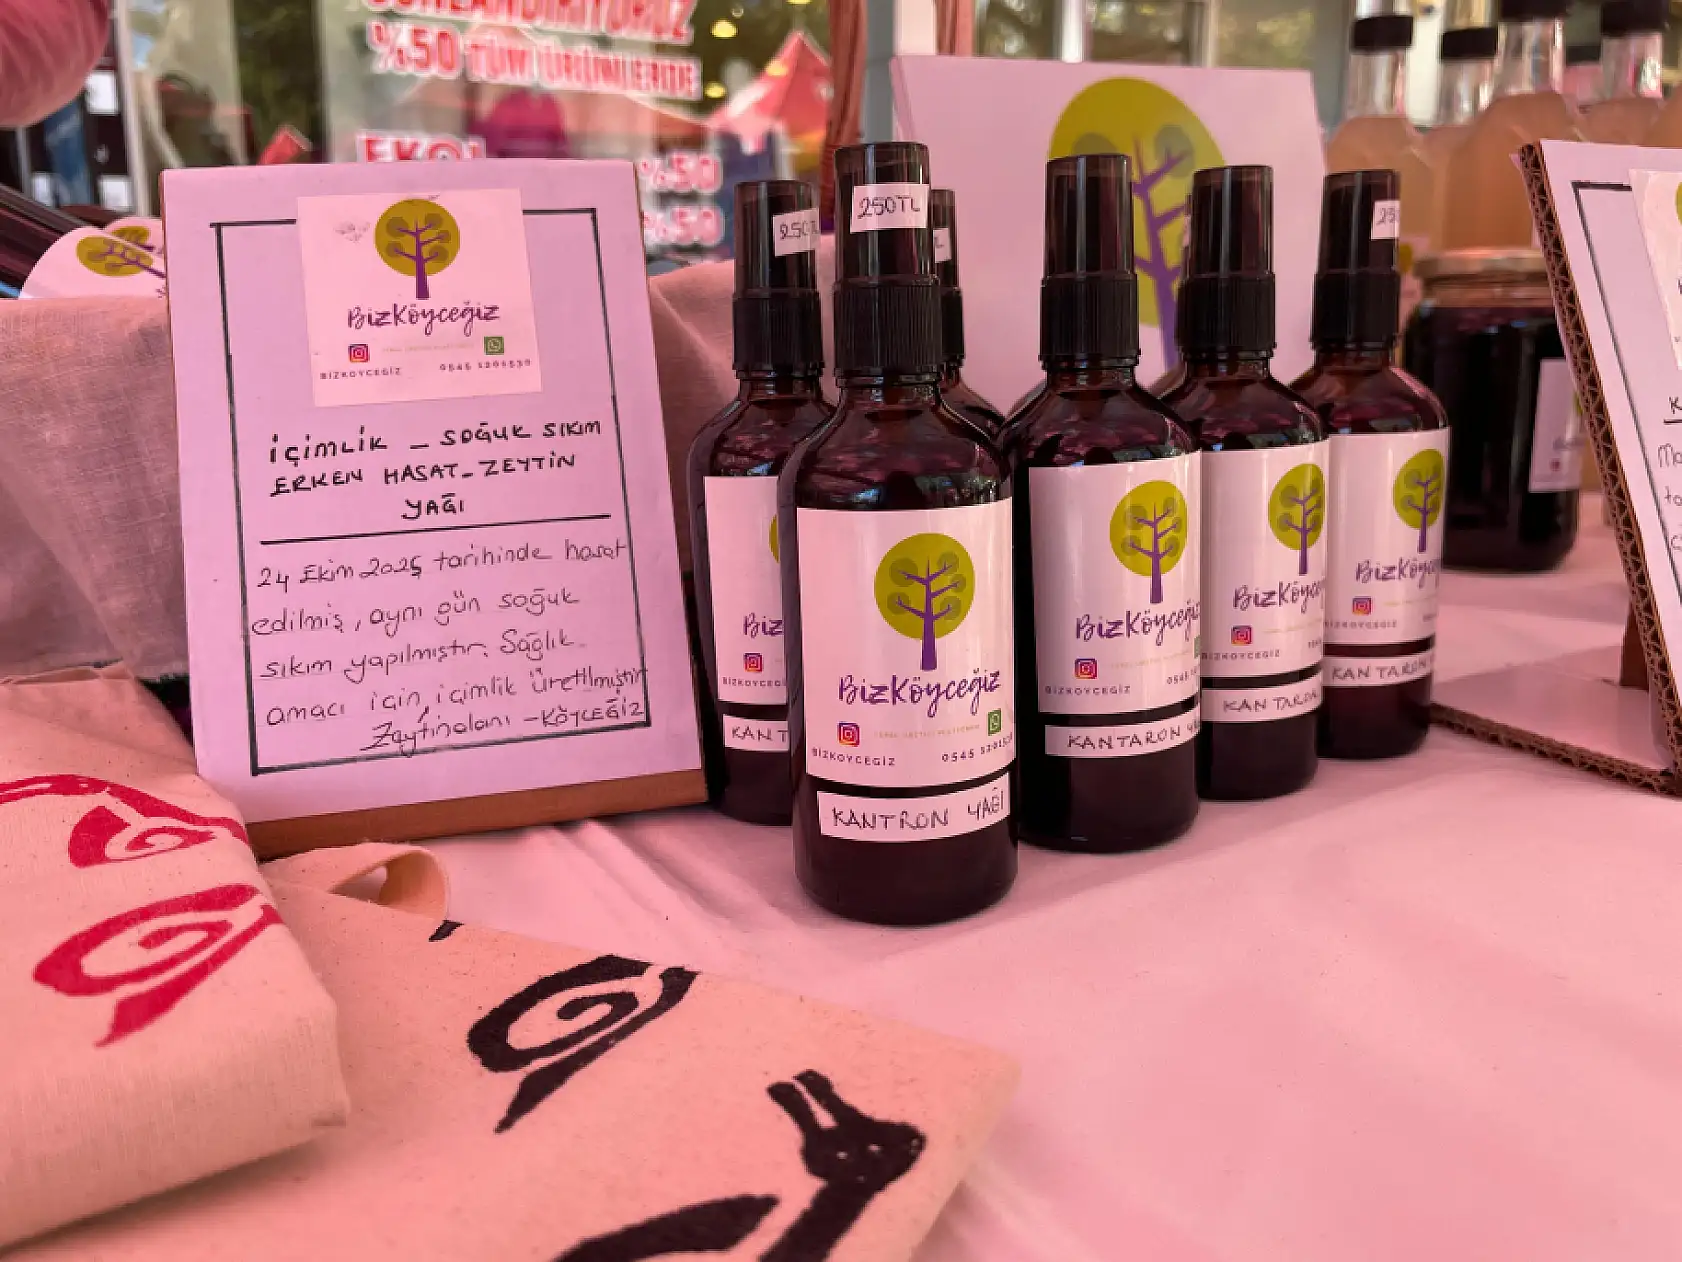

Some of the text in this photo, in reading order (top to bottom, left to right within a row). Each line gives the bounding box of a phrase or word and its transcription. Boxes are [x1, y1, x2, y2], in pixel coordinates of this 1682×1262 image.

[370, 21, 456, 74] %50
[857, 195, 921, 219] 250TL
[347, 301, 500, 337] BizKöyceğiz
[269, 468, 364, 498] ERKEN
[400, 492, 465, 520] YAĞI
[256, 566, 290, 594] 24
[299, 558, 354, 584] Ekim
[432, 542, 553, 571] tarihinde
[564, 538, 627, 562] hasat
[434, 589, 481, 627] gün
[498, 586, 581, 617] soğuk
[499, 628, 575, 662] Sağlık
[837, 667, 1001, 718] BizKöyceğiz
[266, 702, 345, 726] amacı
[831, 806, 949, 831] KANTRON
